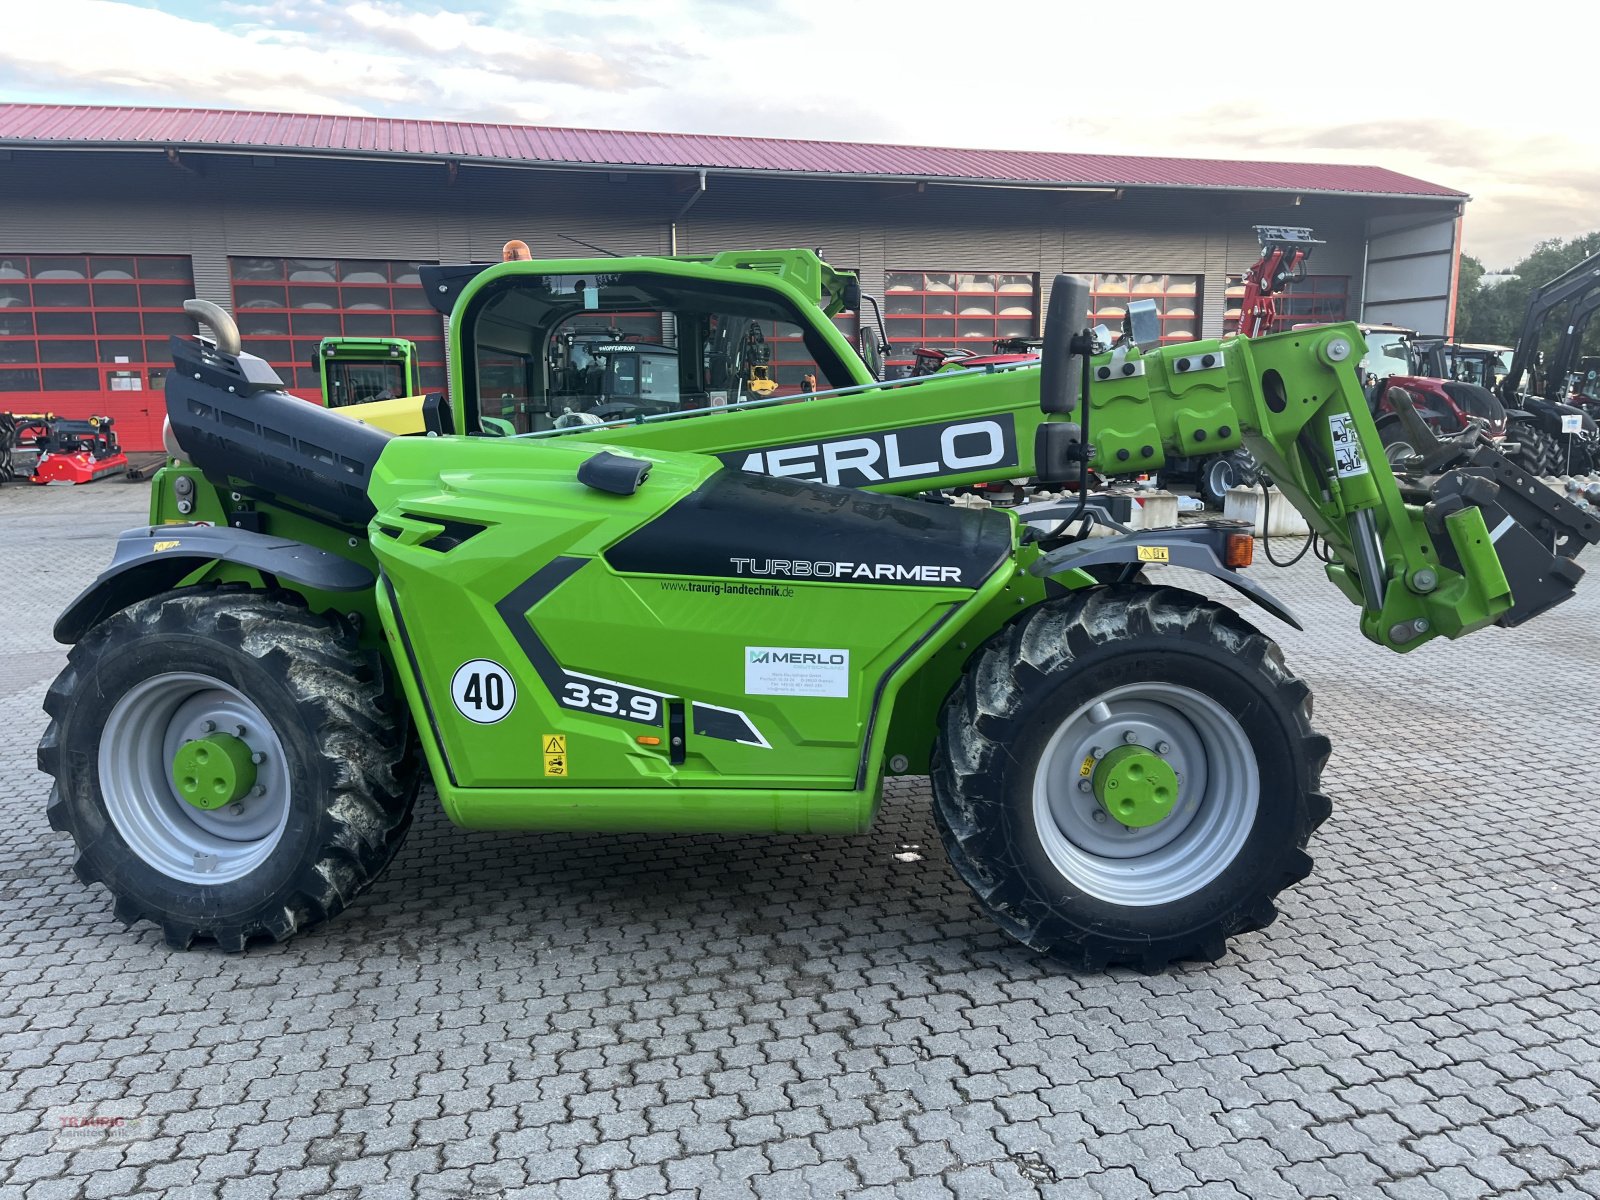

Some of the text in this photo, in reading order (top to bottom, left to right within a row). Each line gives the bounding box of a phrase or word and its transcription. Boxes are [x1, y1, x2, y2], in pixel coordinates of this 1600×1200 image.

[729, 556, 962, 584] TURBOFARMER
[660, 581, 795, 598] www.traurig-landtechnik.de
[772, 652, 845, 665] MERLO
[463, 672, 505, 711] 40
[561, 681, 659, 722] 33.9
